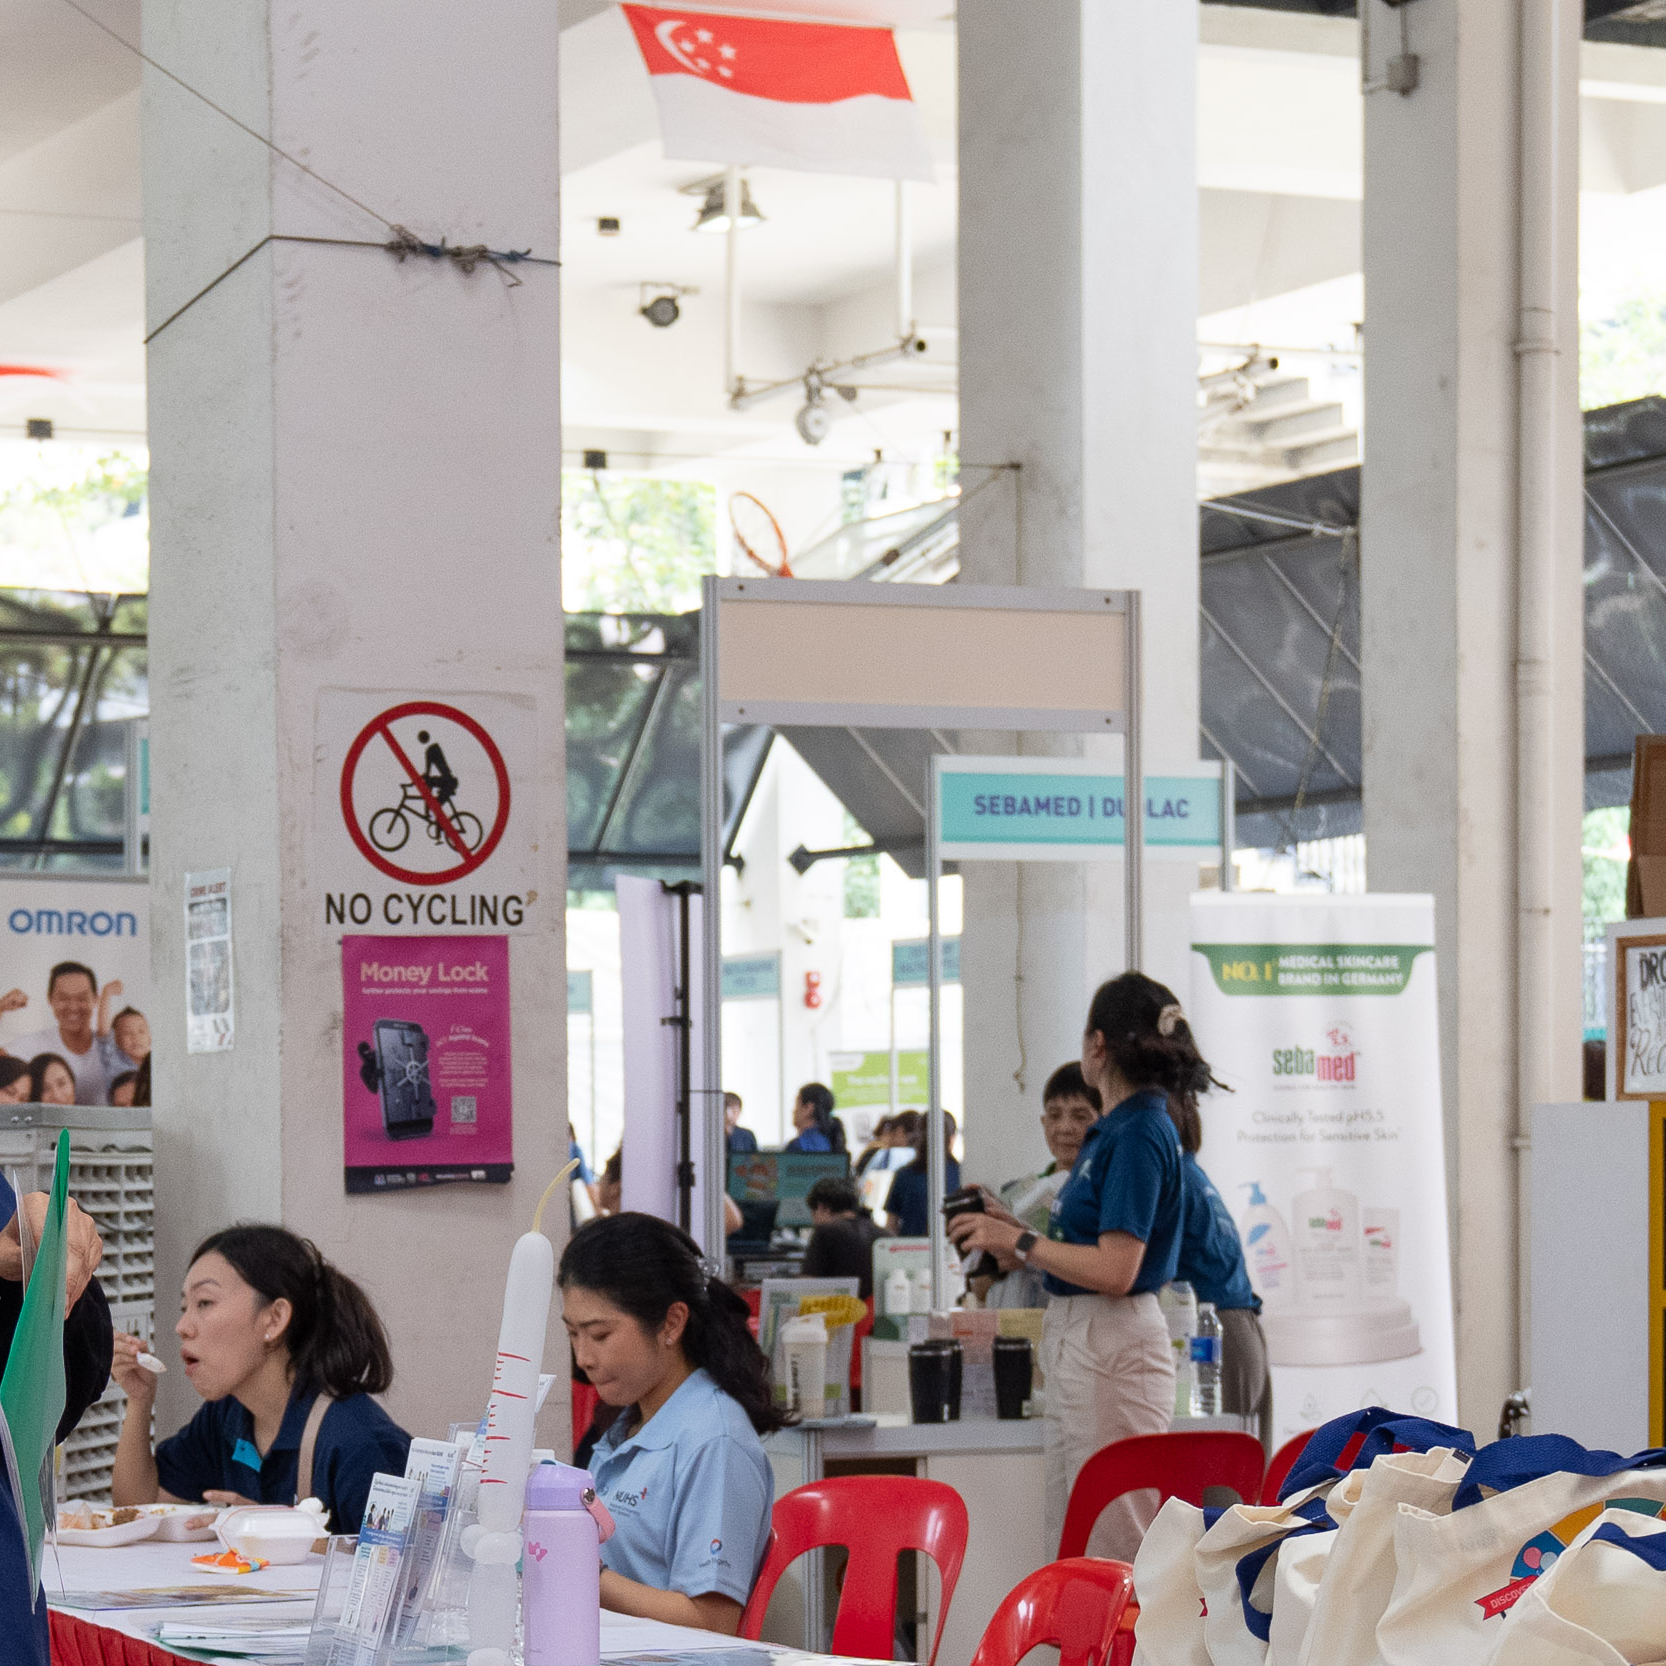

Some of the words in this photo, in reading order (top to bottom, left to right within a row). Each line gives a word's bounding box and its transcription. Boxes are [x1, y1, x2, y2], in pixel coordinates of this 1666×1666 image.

[974, 795, 1081, 817] SEBAMED
[1102, 799, 1190, 819] DULAC
[325, 893, 373, 925] NO
[383, 893, 524, 926] CYCLING
[9, 909, 137, 936] OMRON
[360, 961, 433, 986] Money
[438, 961, 489, 982] Lock
[1278, 955, 1333, 969] MEDICAL
[1337, 956, 1399, 969] SKINCARE
[1278, 972, 1321, 985] BRAND
[1342, 973, 1404, 986] GERMANY
[1273, 1046, 1355, 1082] sebamed
[1252, 1111, 1304, 1125] Clinically
[1308, 1111, 1343, 1123] Tested
[1237, 1131, 1297, 1143] Protection
